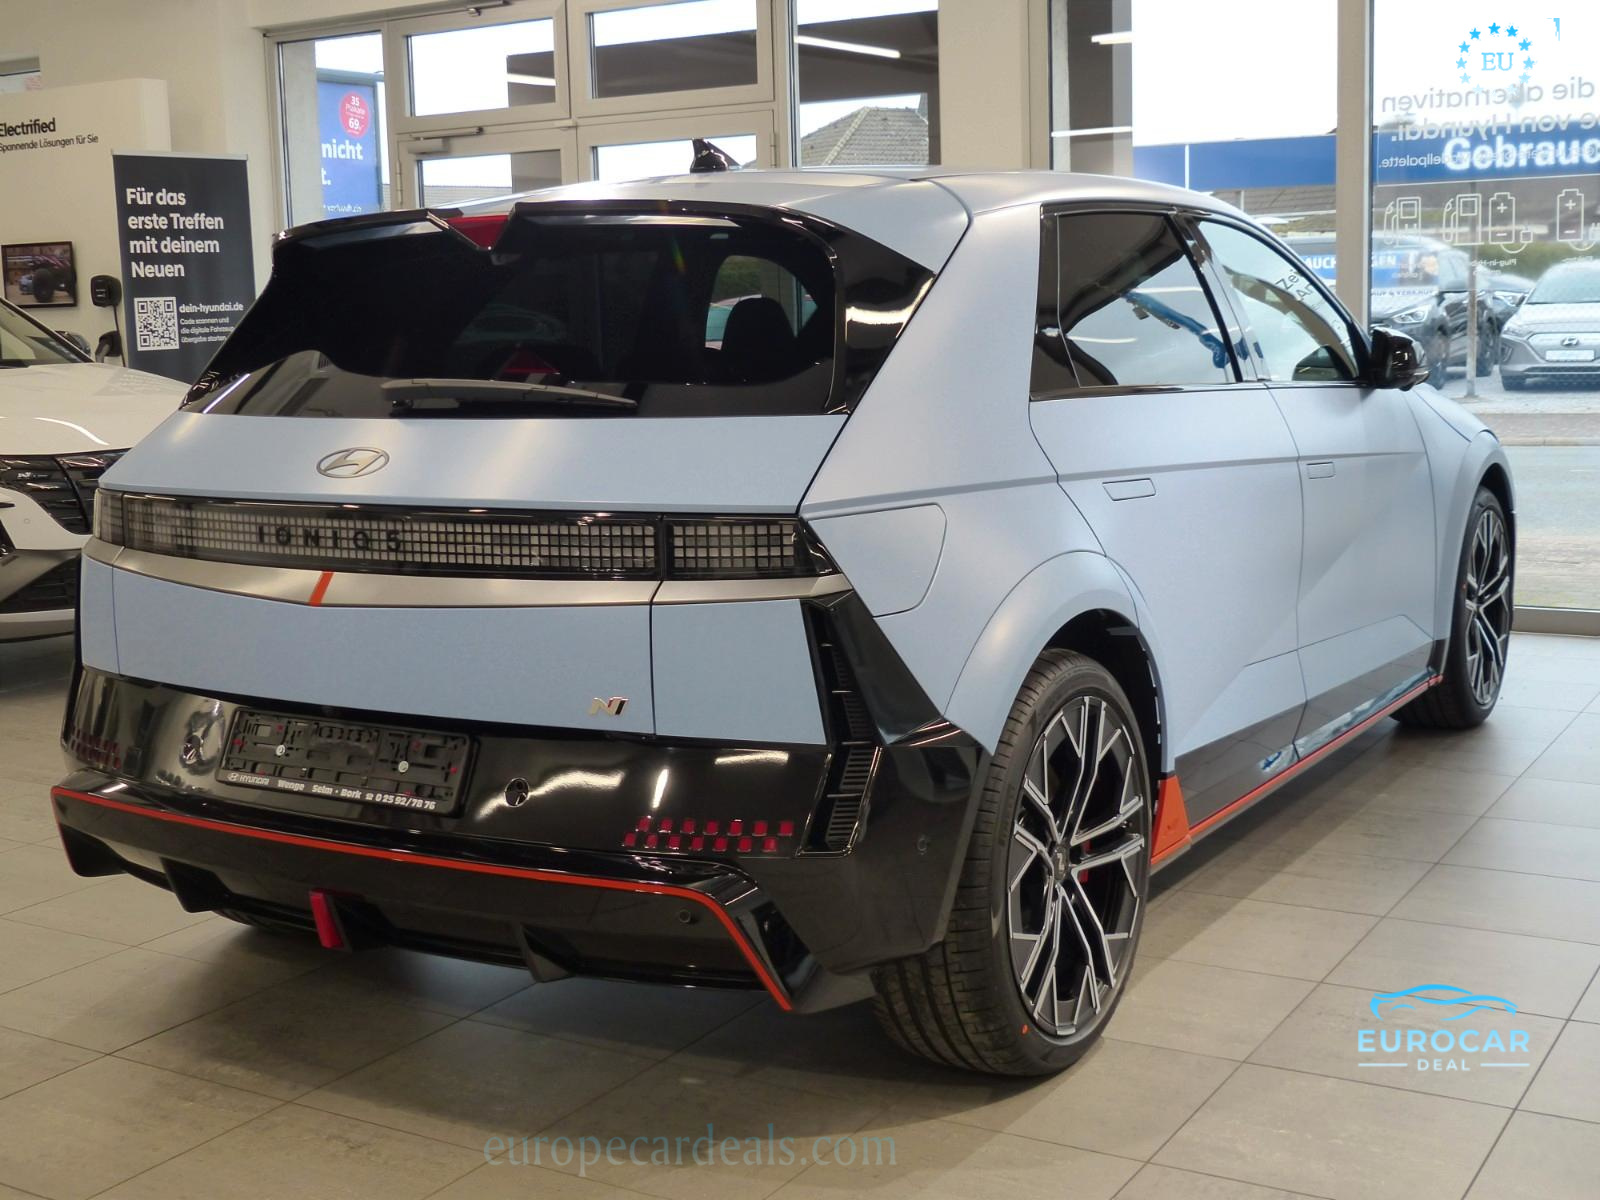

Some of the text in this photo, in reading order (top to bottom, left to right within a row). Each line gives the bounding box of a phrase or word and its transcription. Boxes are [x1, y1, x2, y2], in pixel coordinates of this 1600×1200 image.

[0, 117, 56, 137] Electrified
[0, 133, 99, 153] Spannende Lösungen für Sie
[321, 139, 364, 160] nicht
[126, 187, 186, 206] Für das
[127, 213, 225, 230] erste Treffen
[129, 236, 220, 254] mit deinem
[131, 261, 185, 278] Neuen
[179, 302, 244, 315] dein-hyundai.de
[257, 525, 401, 551] IONIQ 5
[240, 775, 269, 785] HYUNDAI
[340, 788, 362, 799] Bork
